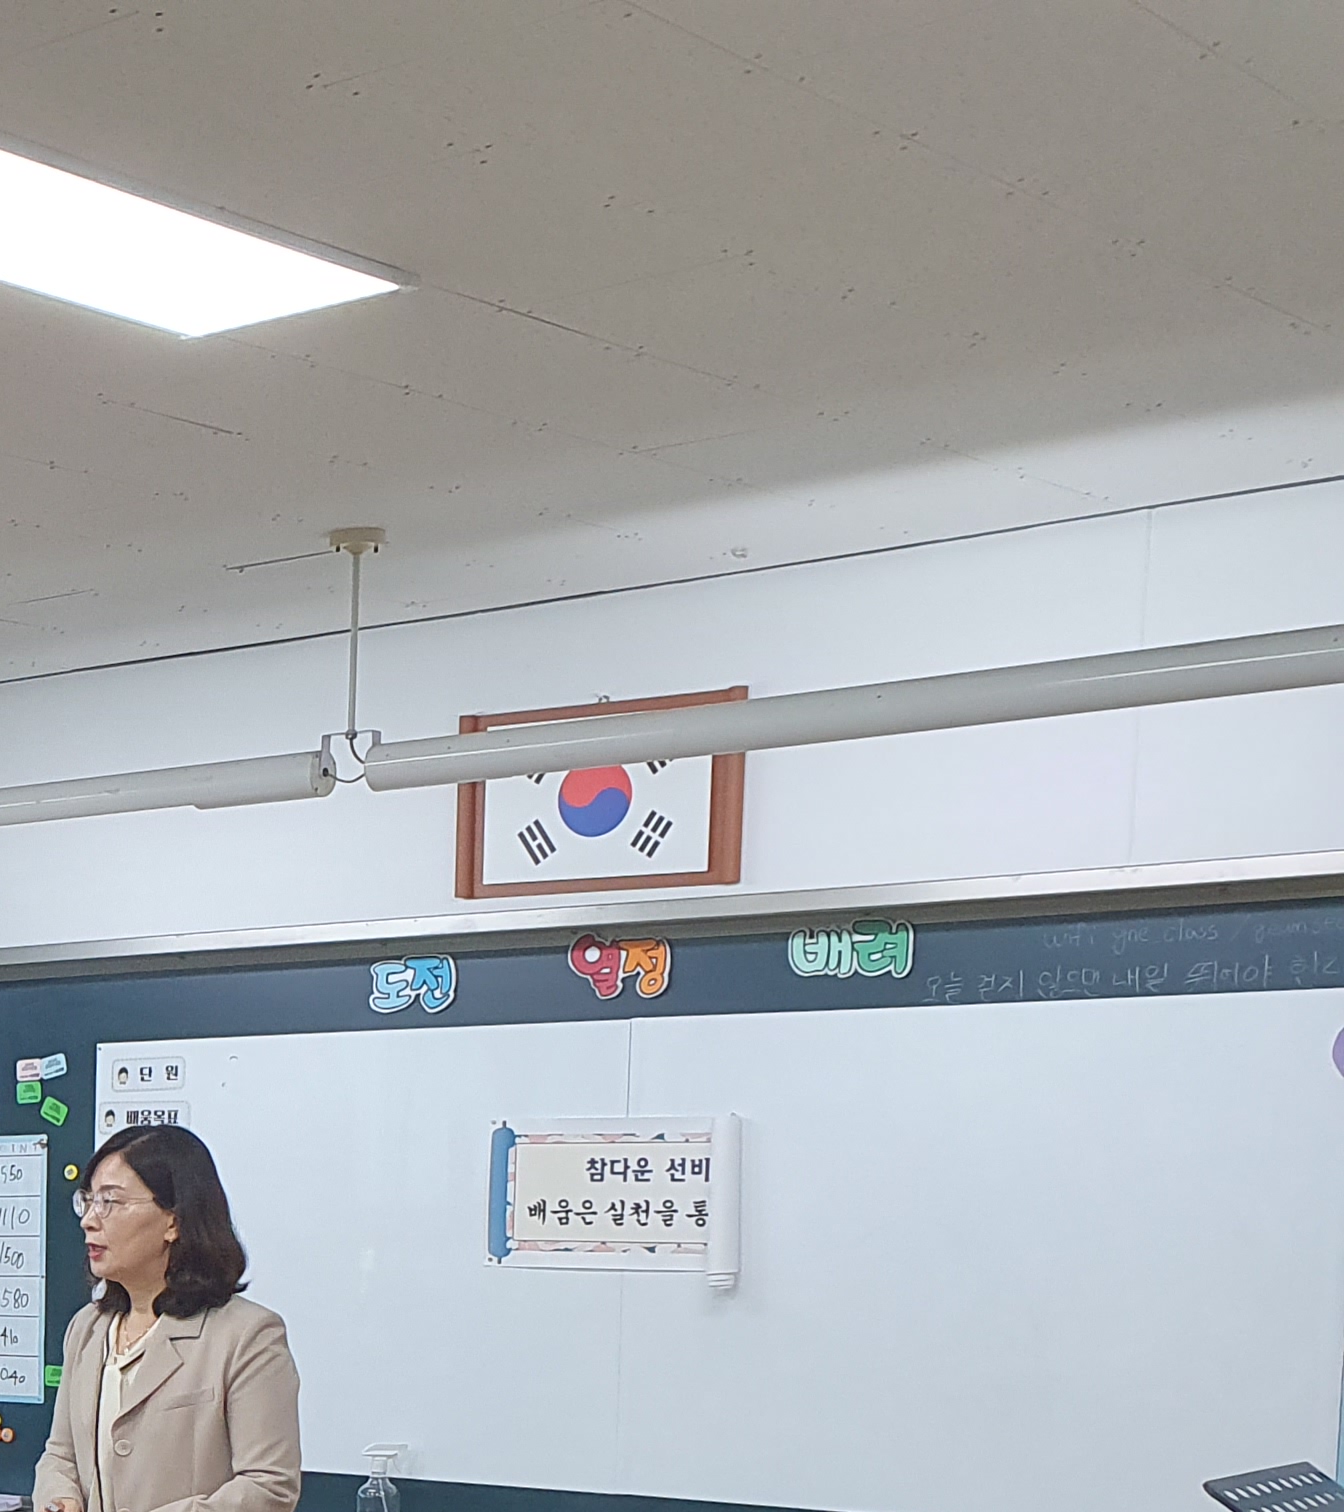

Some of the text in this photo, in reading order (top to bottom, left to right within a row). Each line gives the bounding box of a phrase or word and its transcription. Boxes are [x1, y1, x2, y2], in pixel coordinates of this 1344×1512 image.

[570, 934, 671, 998] 열정
[790, 921, 912, 977] 배려
[370, 956, 456, 1012] 도전
[922, 971, 963, 1004] 오늘
[1112, 963, 1168, 993] 내일
[126, 1109, 179, 1125] 배움목표
[585, 1157, 711, 1183] 참다운 선비
[527, 1199, 709, 1228] 배움은 실천을 통
